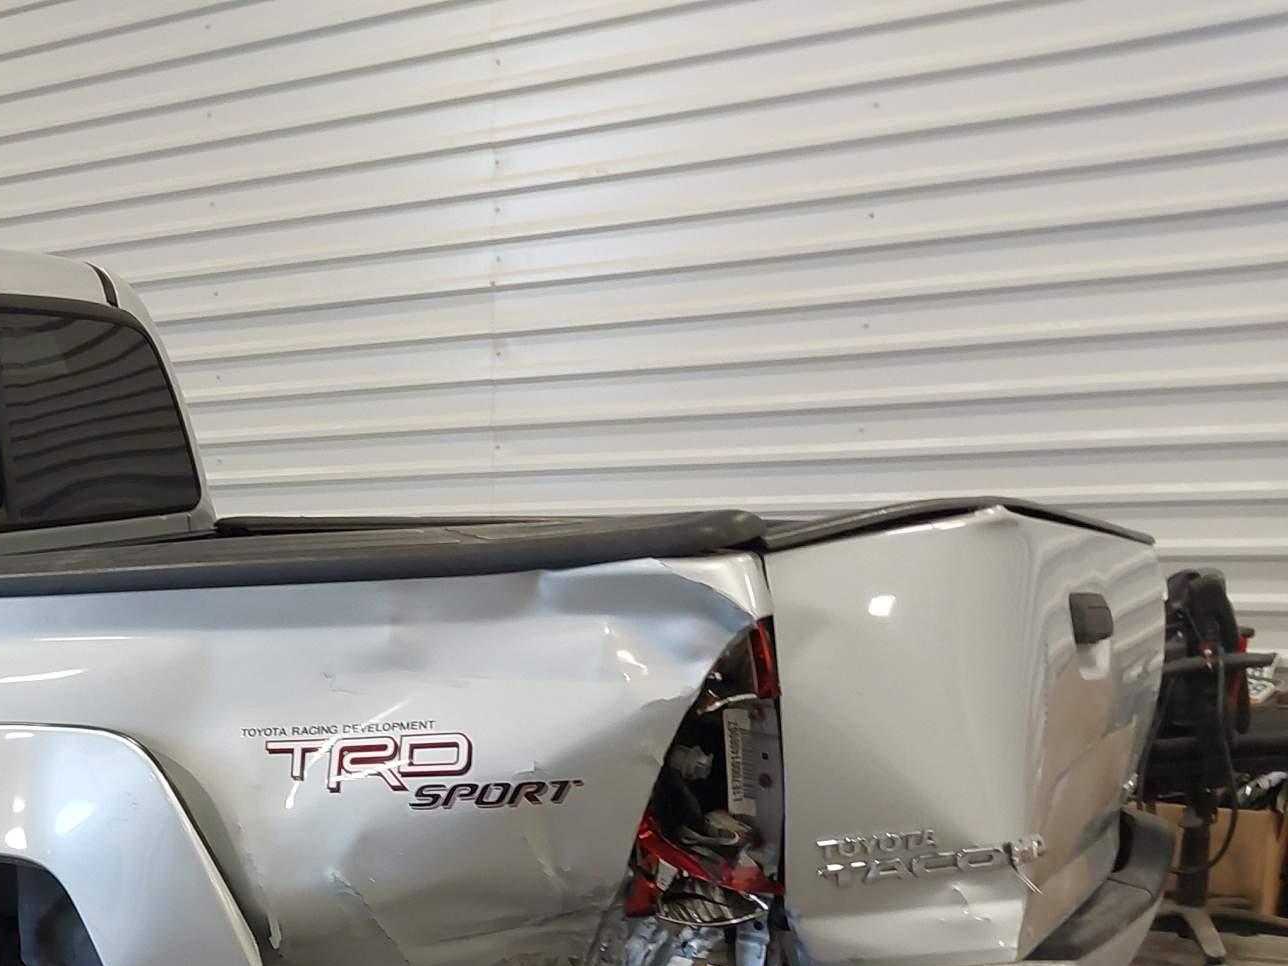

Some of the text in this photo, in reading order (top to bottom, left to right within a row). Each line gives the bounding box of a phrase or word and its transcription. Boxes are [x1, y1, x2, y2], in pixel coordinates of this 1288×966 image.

[240, 719, 437, 738] TOYOTA RACING DEVELOPMENT
[265, 732, 473, 793] TRD
[408, 779, 580, 810] SPORT
[816, 829, 937, 859] TOYOTA
